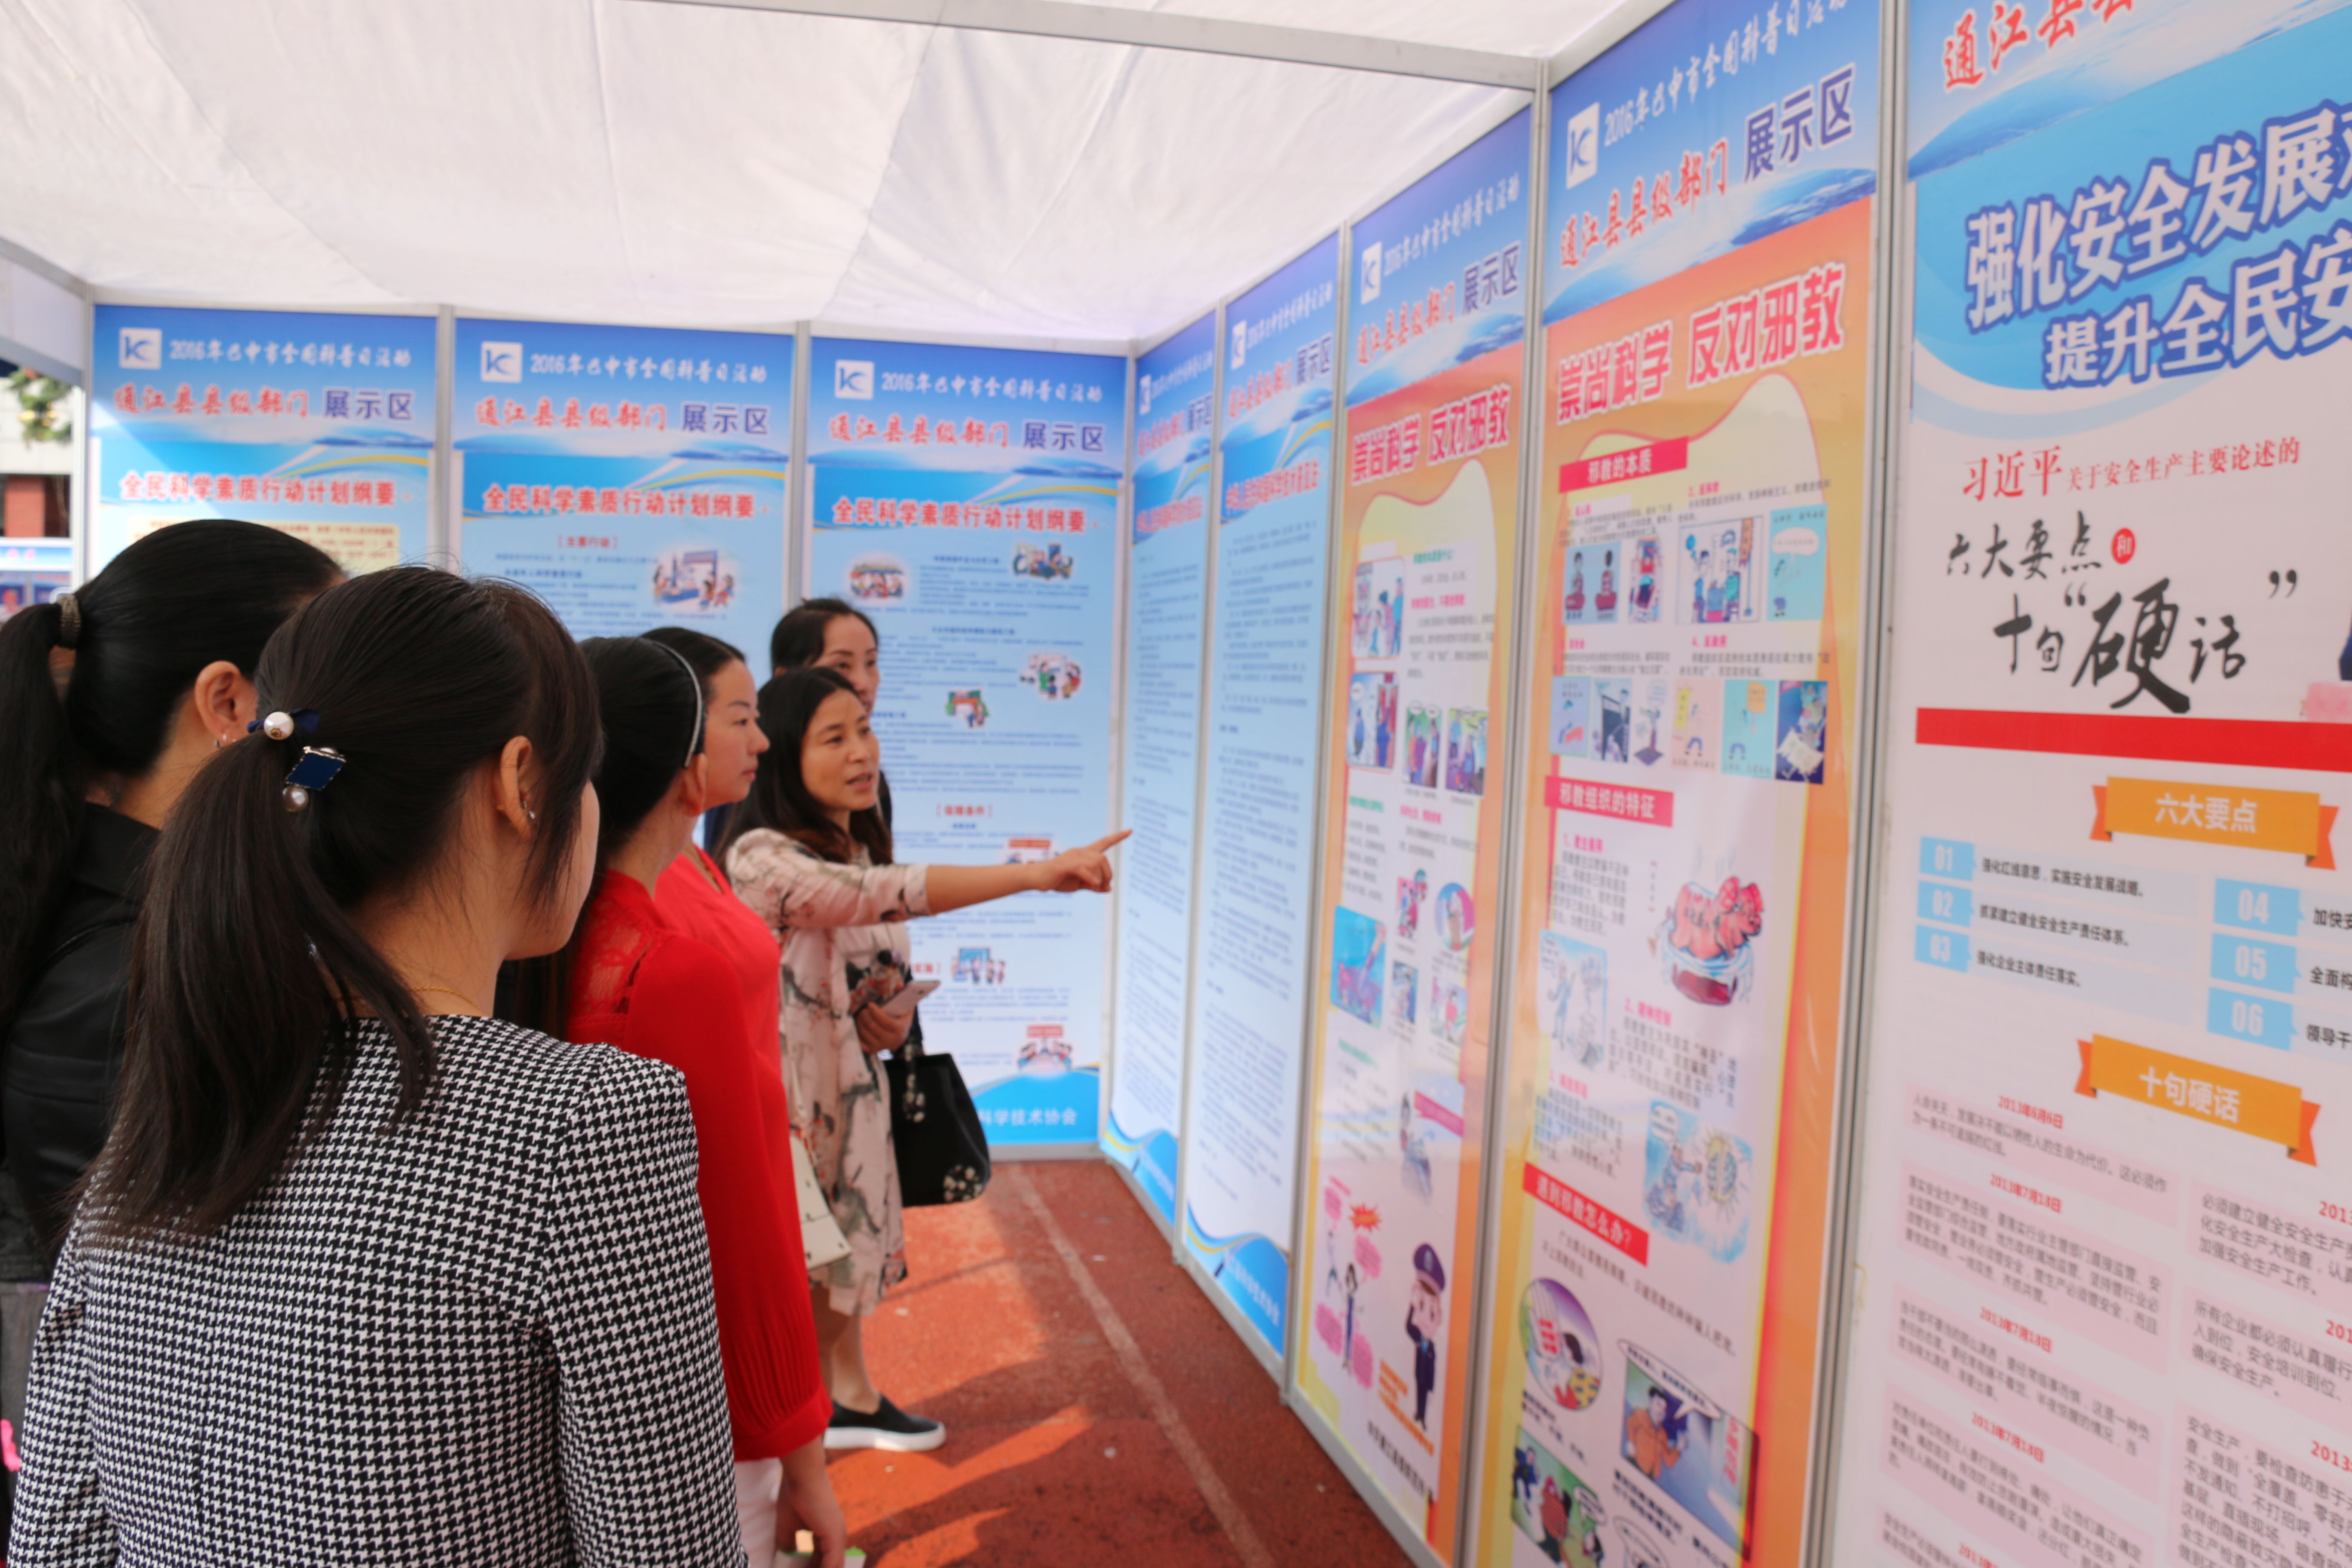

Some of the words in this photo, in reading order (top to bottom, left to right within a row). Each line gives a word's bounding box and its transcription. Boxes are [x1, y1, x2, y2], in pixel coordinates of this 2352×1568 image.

[1944, 0, 2132, 89] 通江县
[1605, 0, 1847, 146] 2016年巴中市全国科普日活
[1561, 140, 1727, 267] 通江县县级部门
[1744, 63, 1856, 183] 展示区
[1964, 100, 2352, 334] 强化安全发展
[1464, 241, 1521, 315] 展示区
[1558, 319, 1672, 421] 崇尚科学
[1687, 263, 1846, 389] 反对邪教
[324, 389, 414, 420] 展示区
[682, 404, 769, 435] 展示区
[1023, 421, 1105, 453] 展示区
[1351, 414, 1421, 486] 崇尚科学
[1427, 384, 1511, 466] 反对邪教
[1962, 445, 2063, 502] 习近平
[2066, 436, 2301, 493] 关于安全生产主要论述的
[483, 484, 755, 519] 全民科学素质行动计划纲要
[833, 496, 1087, 533] 全民科学素质行动计划纲要
[1946, 510, 2103, 580] 六大要点
[2116, 534, 2132, 558] 和
[2154, 792, 2258, 834] 六大要点
[1934, 844, 1954, 872] 01
[1932, 889, 1952, 917] 02
[2238, 888, 2269, 924] 04
[1929, 933, 1951, 963] 03
[2236, 944, 2267, 980] 05
[2232, 1000, 2264, 1037] 06
[2306, 1024, 2352, 1049] 领导干
[2139, 1066, 2240, 1124] 十句硬话
[2319, 1200, 2352, 1226] 201
[2311, 1440, 2352, 1473] 2013
